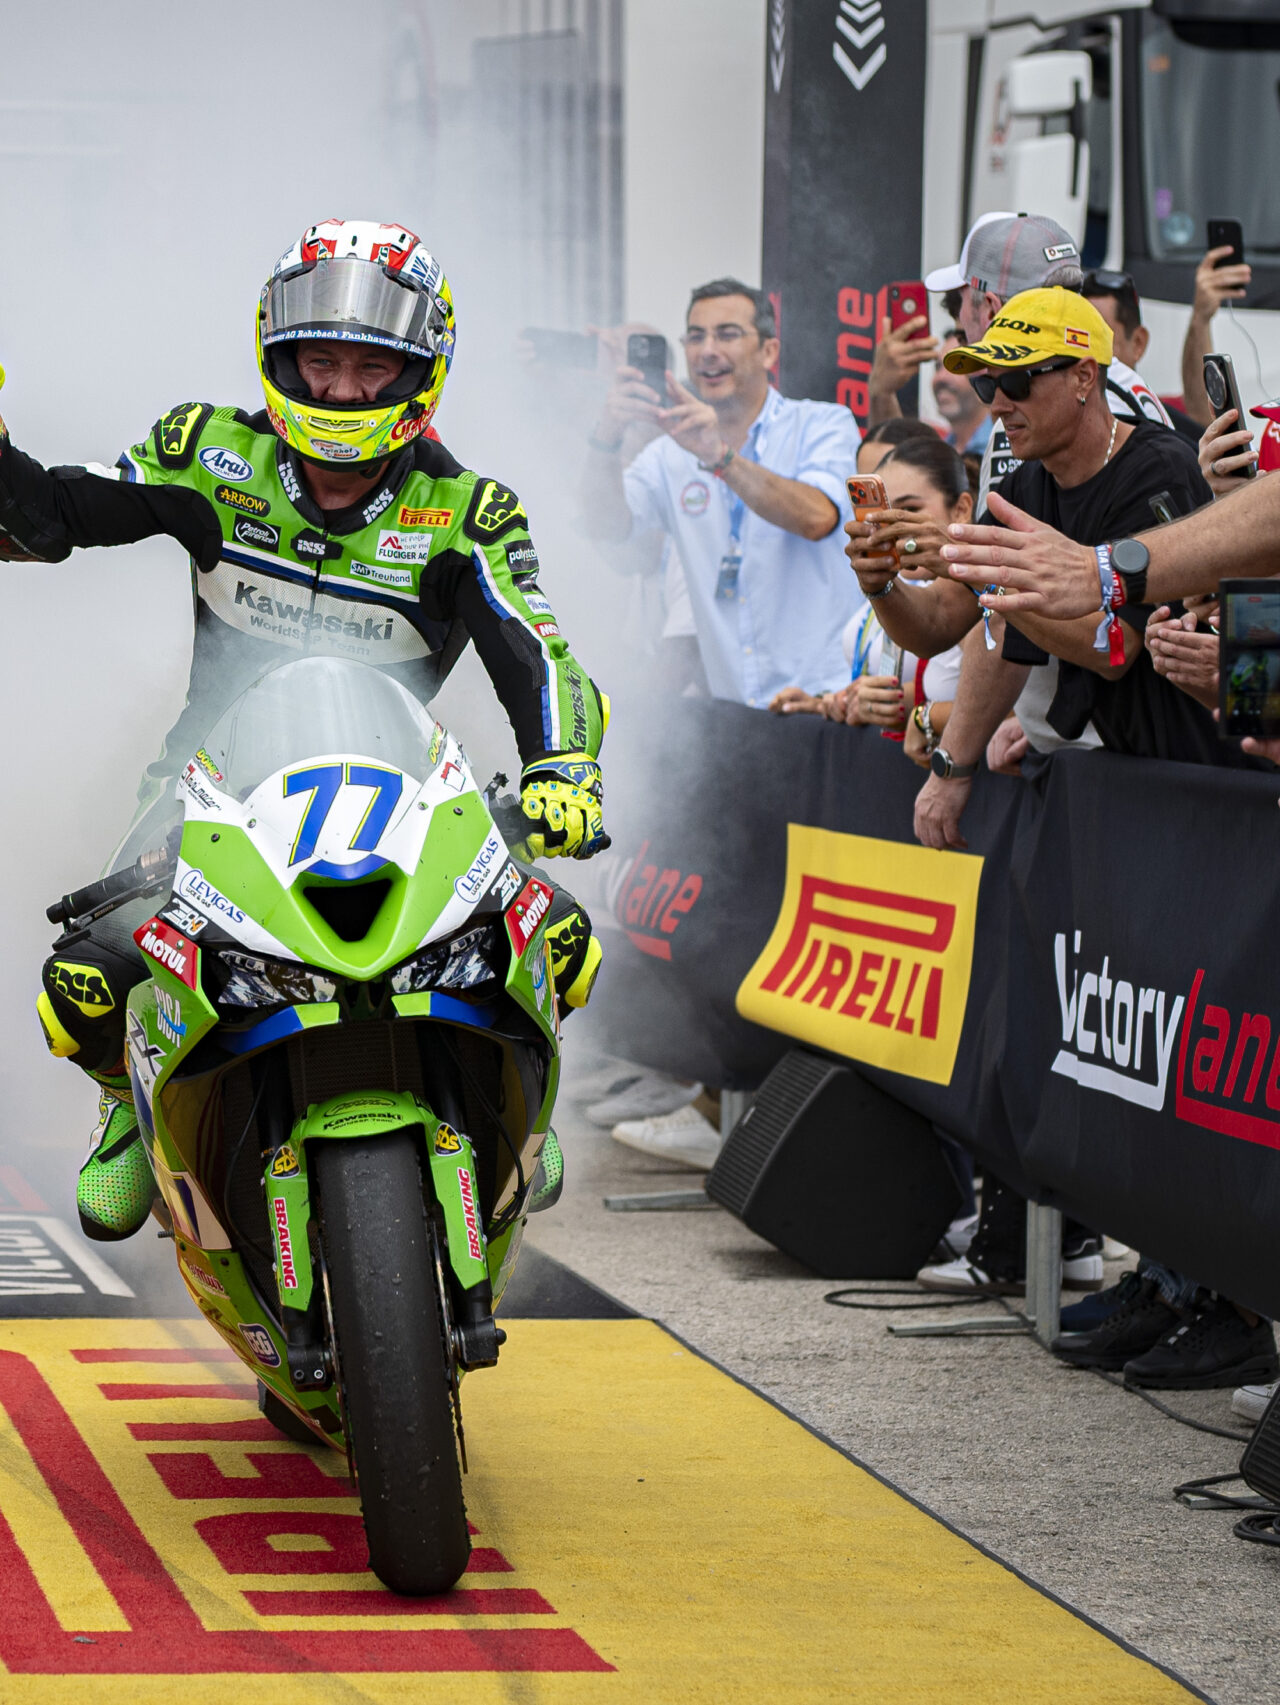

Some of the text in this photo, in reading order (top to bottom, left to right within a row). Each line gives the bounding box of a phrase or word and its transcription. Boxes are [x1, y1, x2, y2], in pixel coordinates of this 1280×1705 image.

[203, 451, 246, 476] Arai
[220, 488, 267, 512] ARROW
[401, 507, 452, 527] PIRELLI
[371, 570, 411, 583] Treuhand
[234, 581, 394, 641] Kawasaki
[282, 762, 404, 868] 77
[461, 837, 499, 890] LEVIGAS
[189, 876, 246, 924] LEVIGAS
[518, 891, 550, 940] MOTUL
[140, 931, 187, 975] MOTUL
[758, 873, 956, 1040] PIRELLI
[1050, 929, 1186, 1112] Victory
[323, 1112, 402, 1131] Kawasaki
[457, 1168, 483, 1260] BRAKING
[273, 1198, 298, 1289] BRAKING
